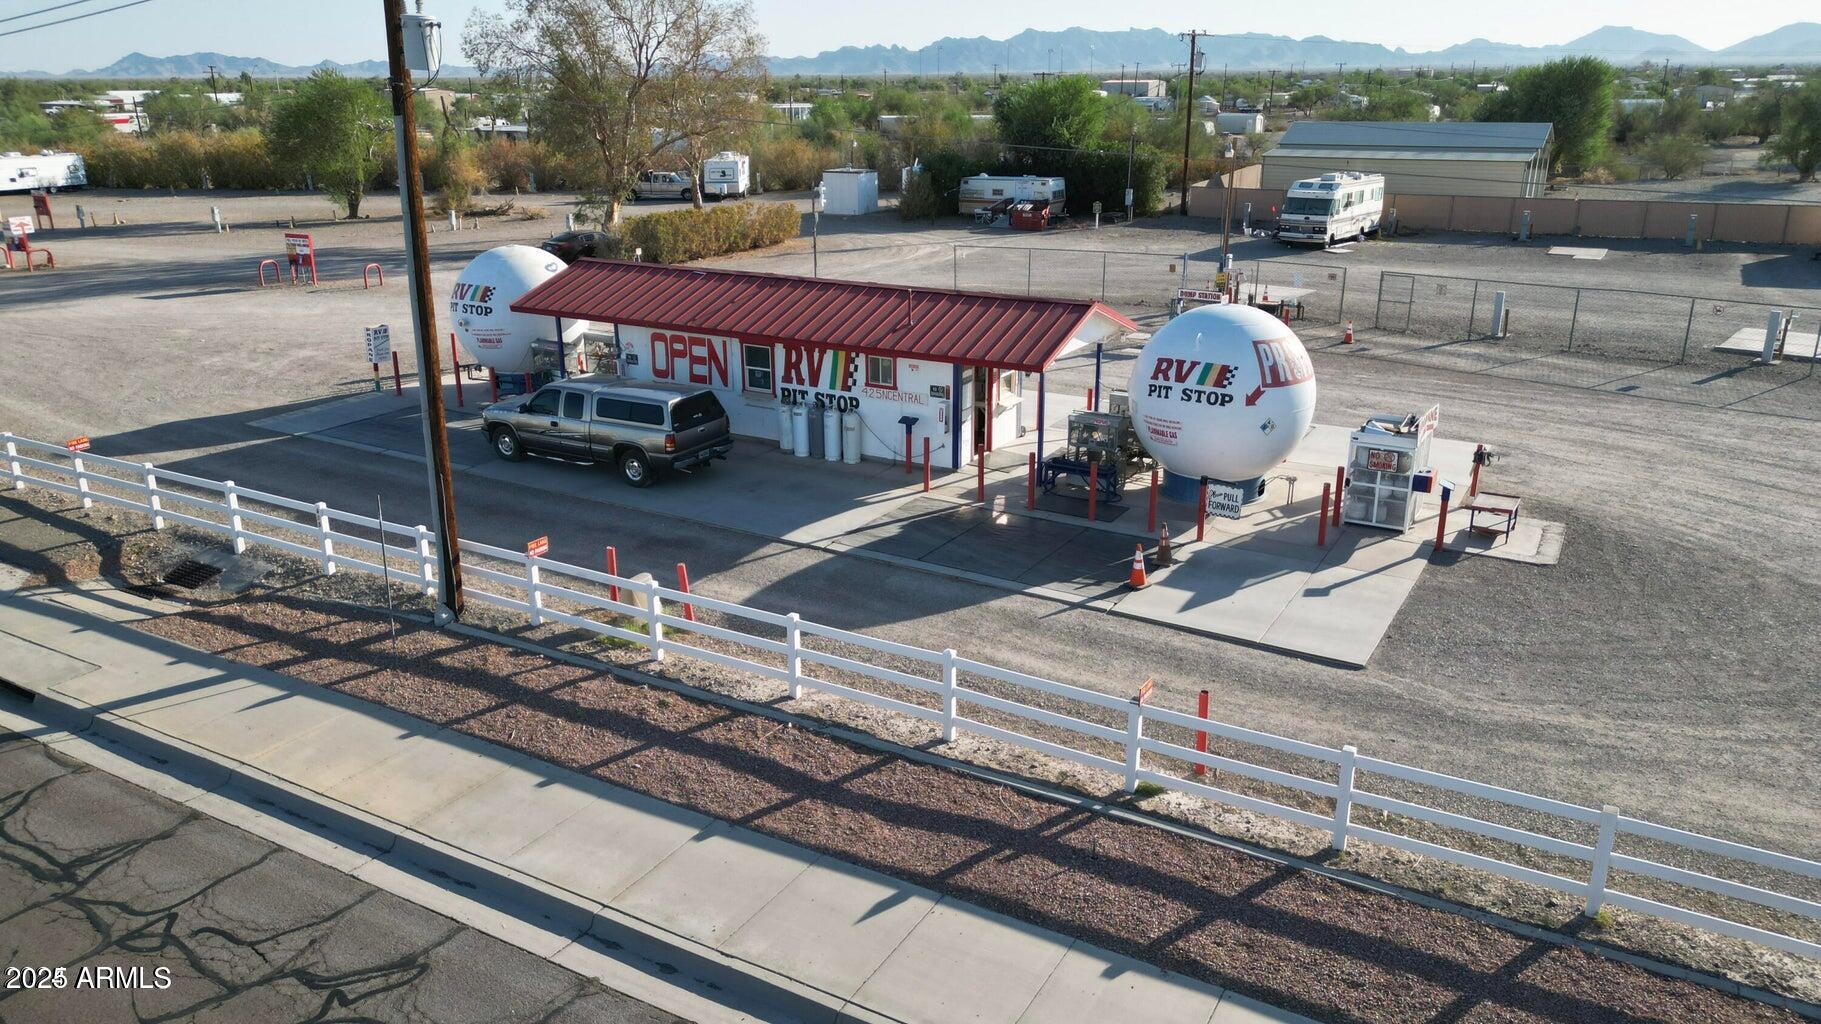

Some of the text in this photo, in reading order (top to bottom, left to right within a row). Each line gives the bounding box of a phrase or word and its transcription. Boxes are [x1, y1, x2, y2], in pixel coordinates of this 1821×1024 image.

[451, 283, 473, 300] RV
[1198, 292, 1222, 300] STATION
[462, 304, 493, 316] STOP
[650, 332, 729, 387] OPEN
[781, 346, 827, 388] RV
[1150, 357, 1201, 384] RV
[780, 387, 861, 413] PIT STOP
[1147, 384, 1234, 407] PIT STOP
[1369, 460, 1397, 471] SMOKING
[1223, 492, 1239, 503] PULL
[1208, 500, 1240, 514] FORWARD
